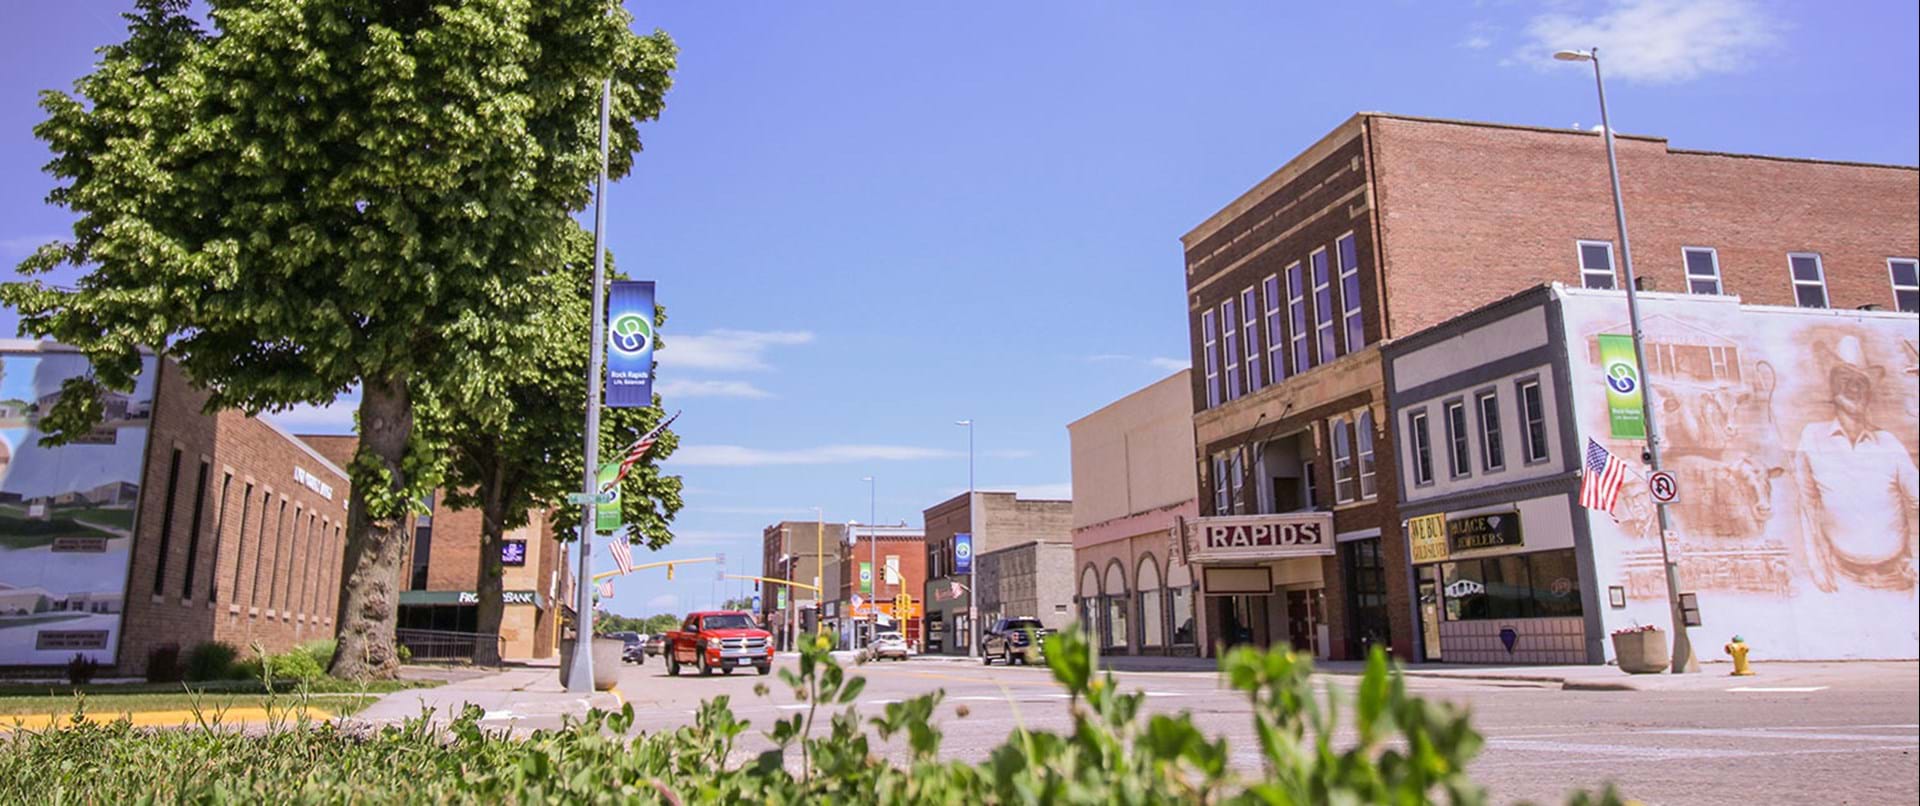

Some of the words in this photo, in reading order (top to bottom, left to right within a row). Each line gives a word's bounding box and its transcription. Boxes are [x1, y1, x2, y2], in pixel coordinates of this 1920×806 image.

[611, 370, 626, 378] Rock
[628, 370, 648, 379] Rapids
[1211, 522, 1317, 547] RAPIDS
[1410, 518, 1425, 539] WE
[1426, 516, 1443, 538] BUY
